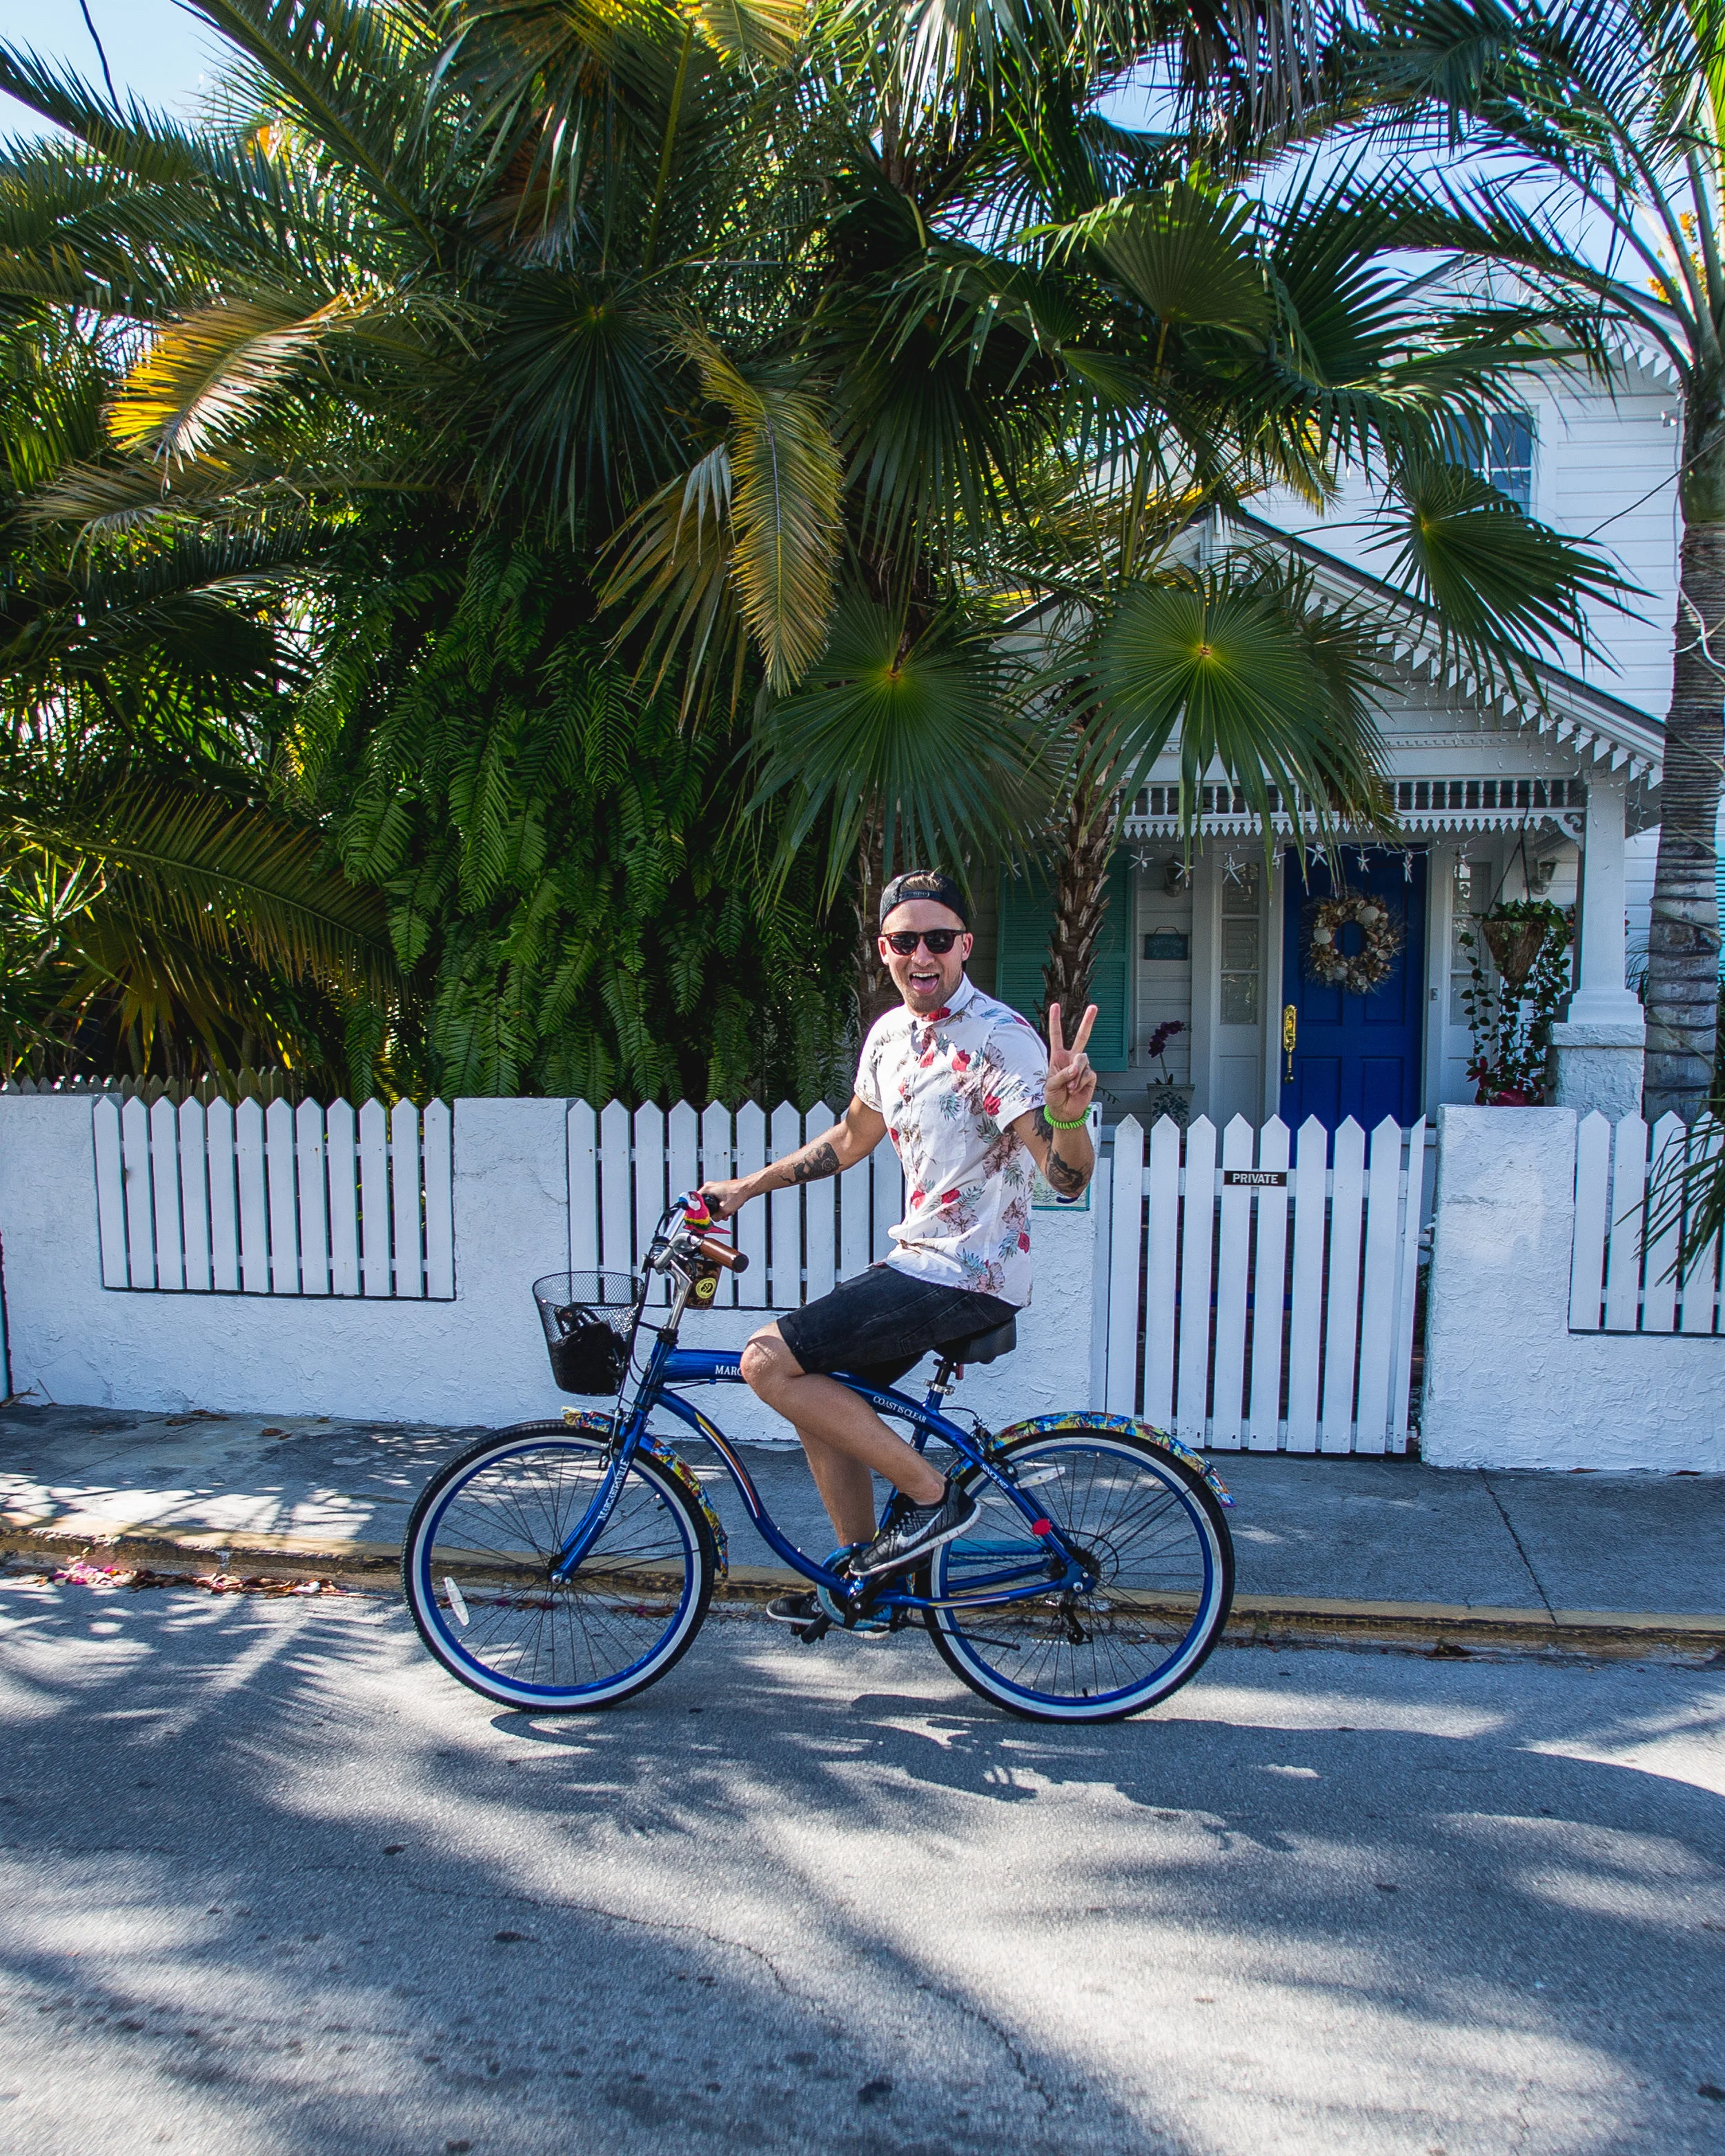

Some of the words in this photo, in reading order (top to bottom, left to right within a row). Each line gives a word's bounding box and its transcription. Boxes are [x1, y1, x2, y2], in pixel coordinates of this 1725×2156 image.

[1232, 1173, 1279, 1184] PRIVATE
[873, 1396, 898, 1410] COAST
[904, 1408, 927, 1423] CLEAR
[980, 1463, 999, 1481] SINCE
